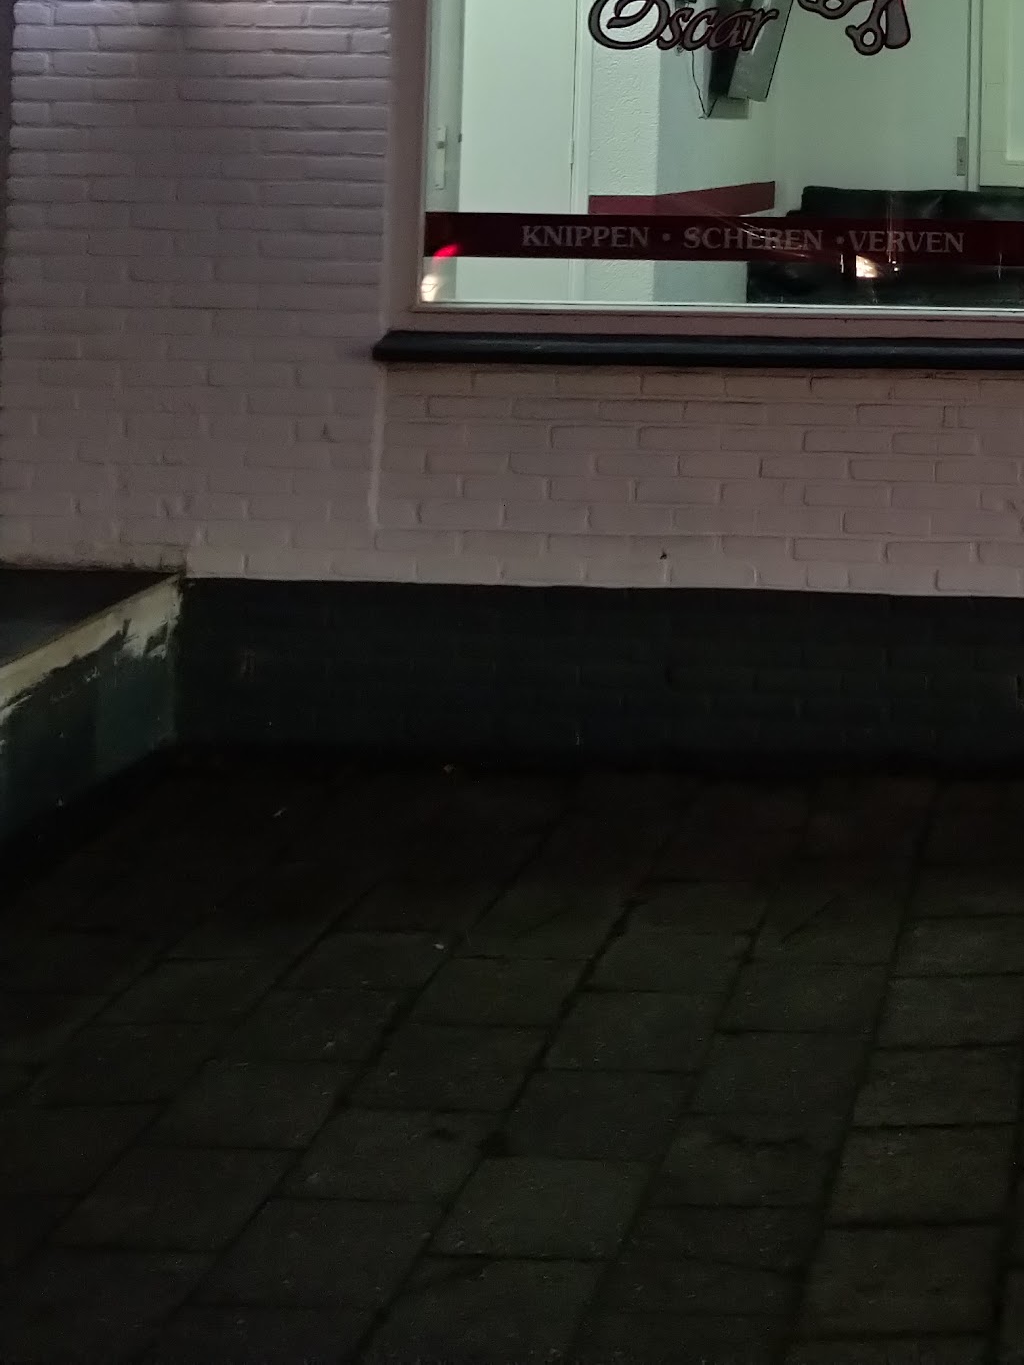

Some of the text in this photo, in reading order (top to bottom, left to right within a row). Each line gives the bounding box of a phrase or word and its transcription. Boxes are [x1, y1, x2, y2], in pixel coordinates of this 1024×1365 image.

[520, 224, 966, 254] KNIPPEN SCHEREN VERVEN
